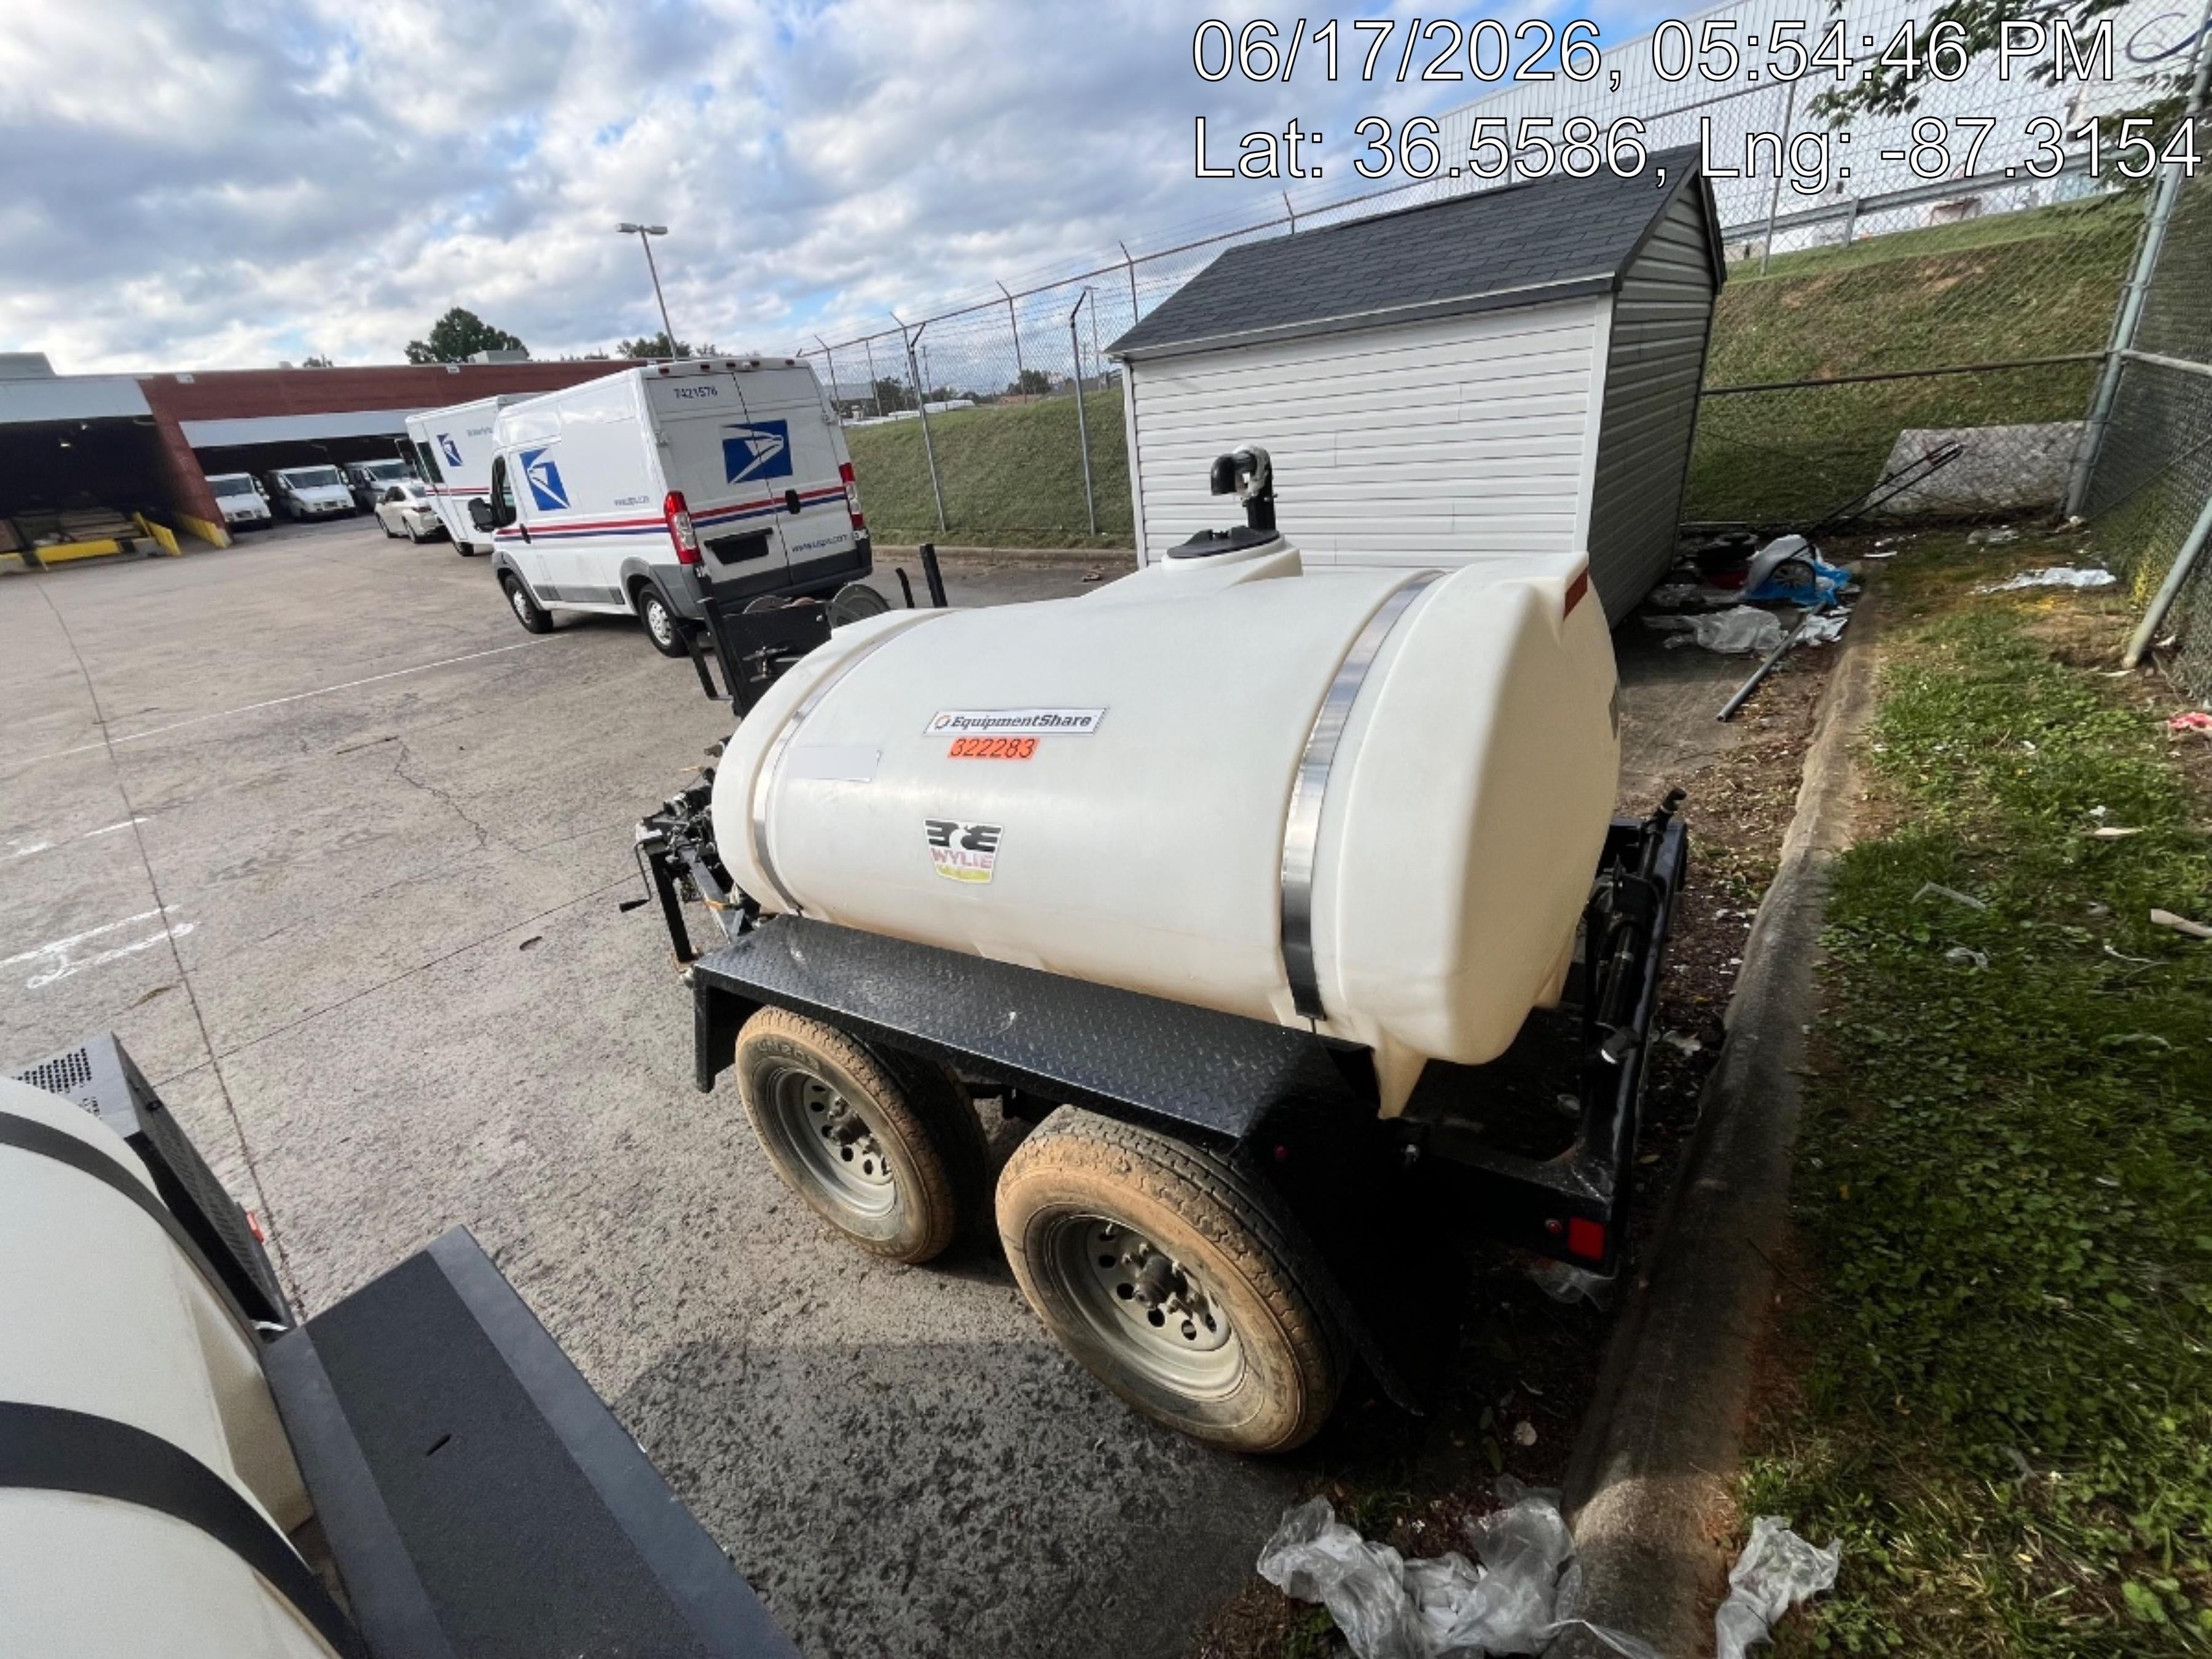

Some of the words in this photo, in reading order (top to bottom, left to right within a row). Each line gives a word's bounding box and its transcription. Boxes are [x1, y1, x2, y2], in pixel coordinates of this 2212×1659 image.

[951, 714, 1092, 730] EquipmentShare
[950, 738, 1035, 758] 322283
[930, 847, 994, 869] WYLIE
